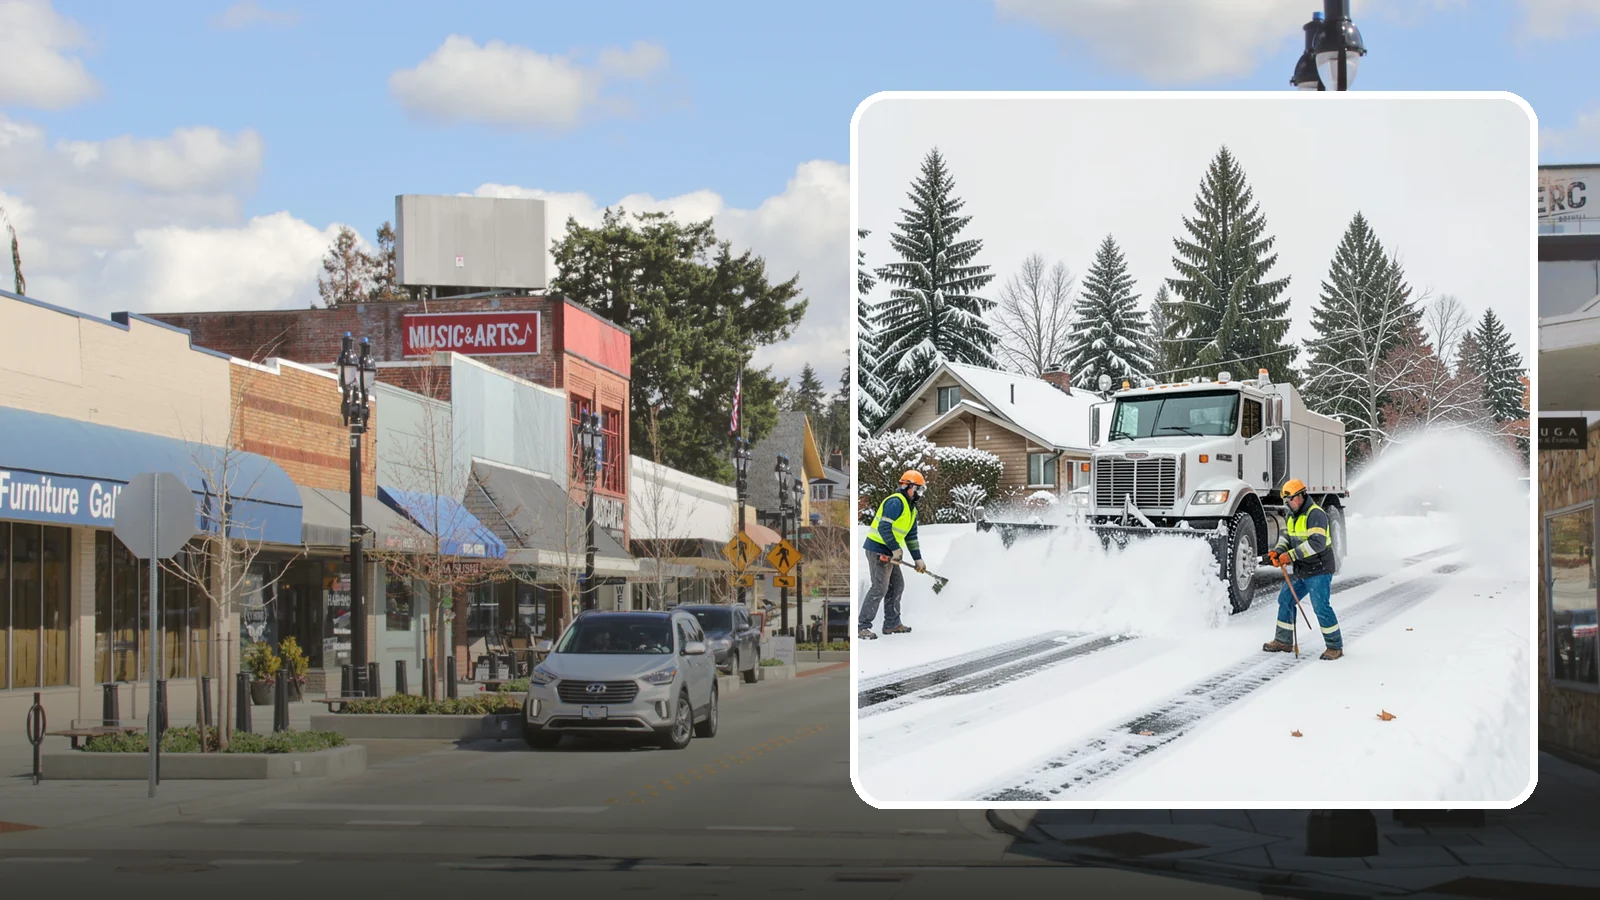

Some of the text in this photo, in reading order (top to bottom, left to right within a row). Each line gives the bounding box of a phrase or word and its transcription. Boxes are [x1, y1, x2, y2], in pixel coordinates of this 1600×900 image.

[0, 472, 122, 518] Furniture Gal
[453, 563, 479, 573] SUSHI
